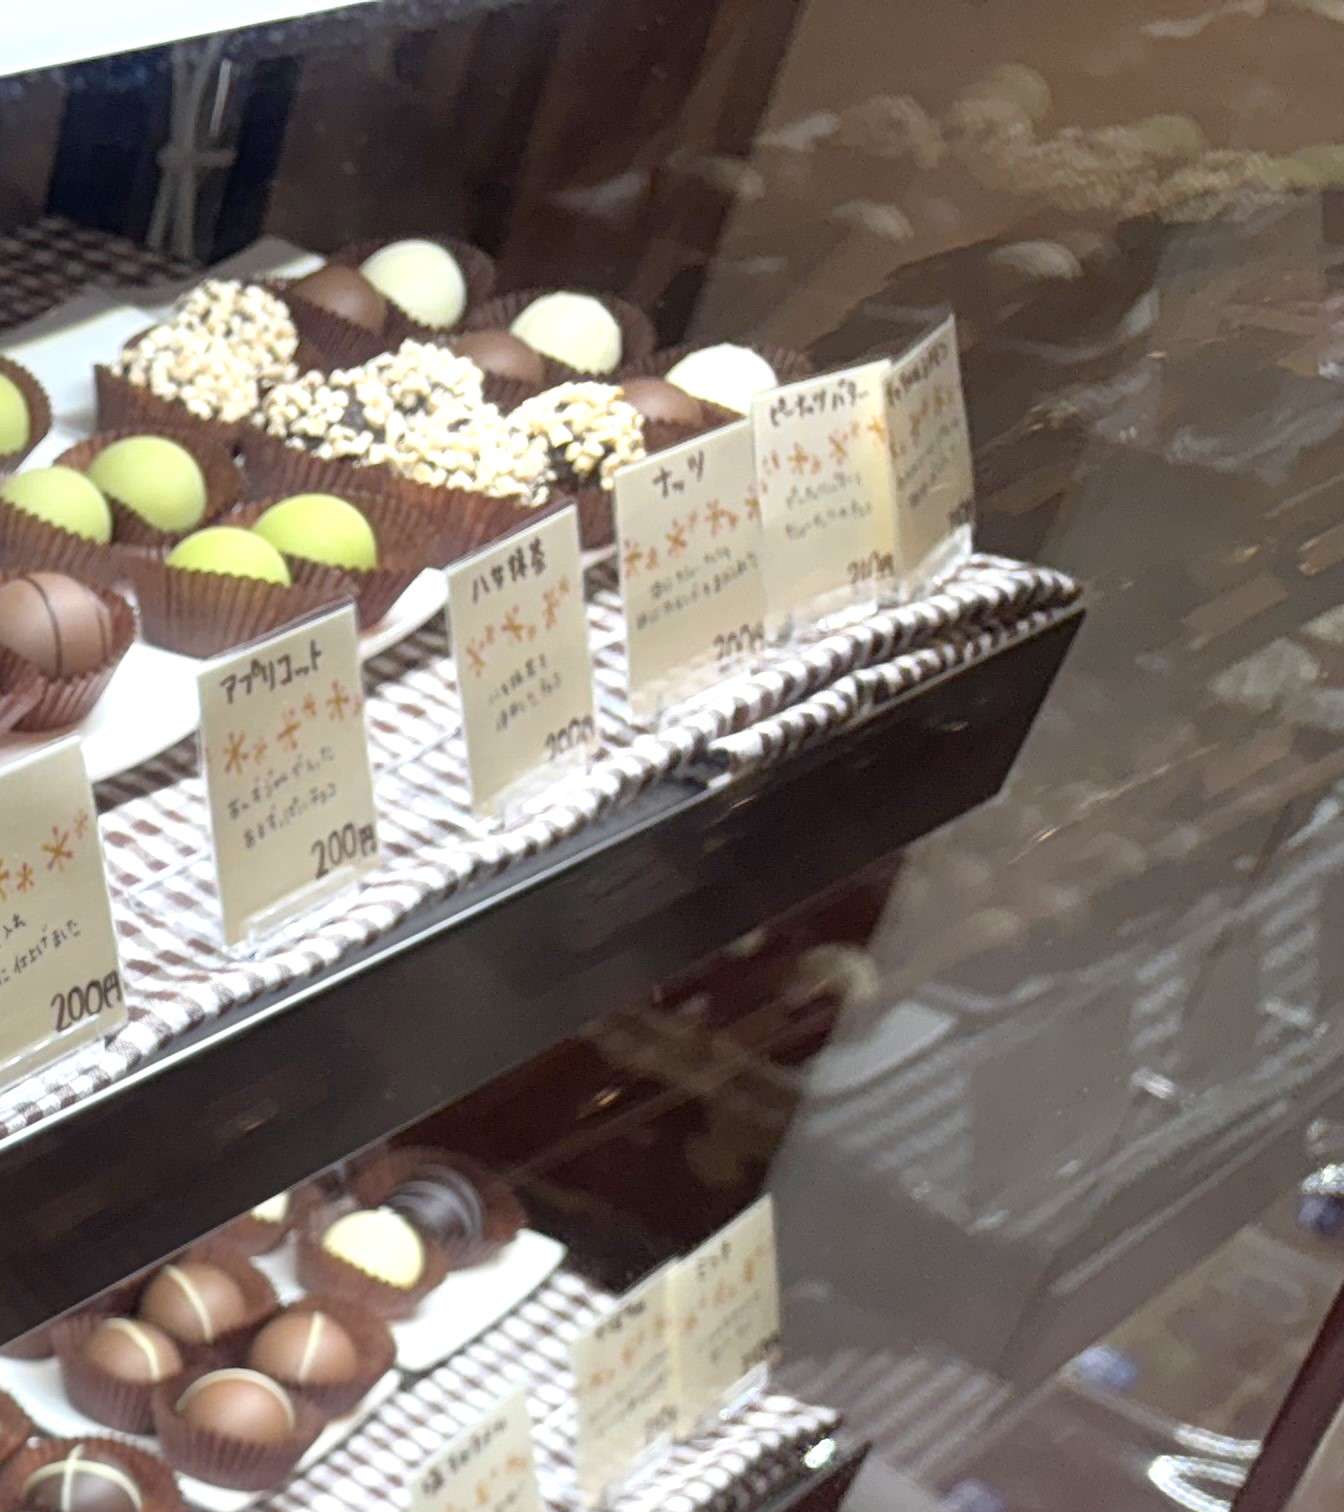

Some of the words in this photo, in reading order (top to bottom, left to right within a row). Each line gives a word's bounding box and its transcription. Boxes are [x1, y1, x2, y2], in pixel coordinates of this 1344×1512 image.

[220, 639, 322, 704] アプリコット
[310, 822, 378, 880] 200円
[50, 969, 124, 1033] 200円
